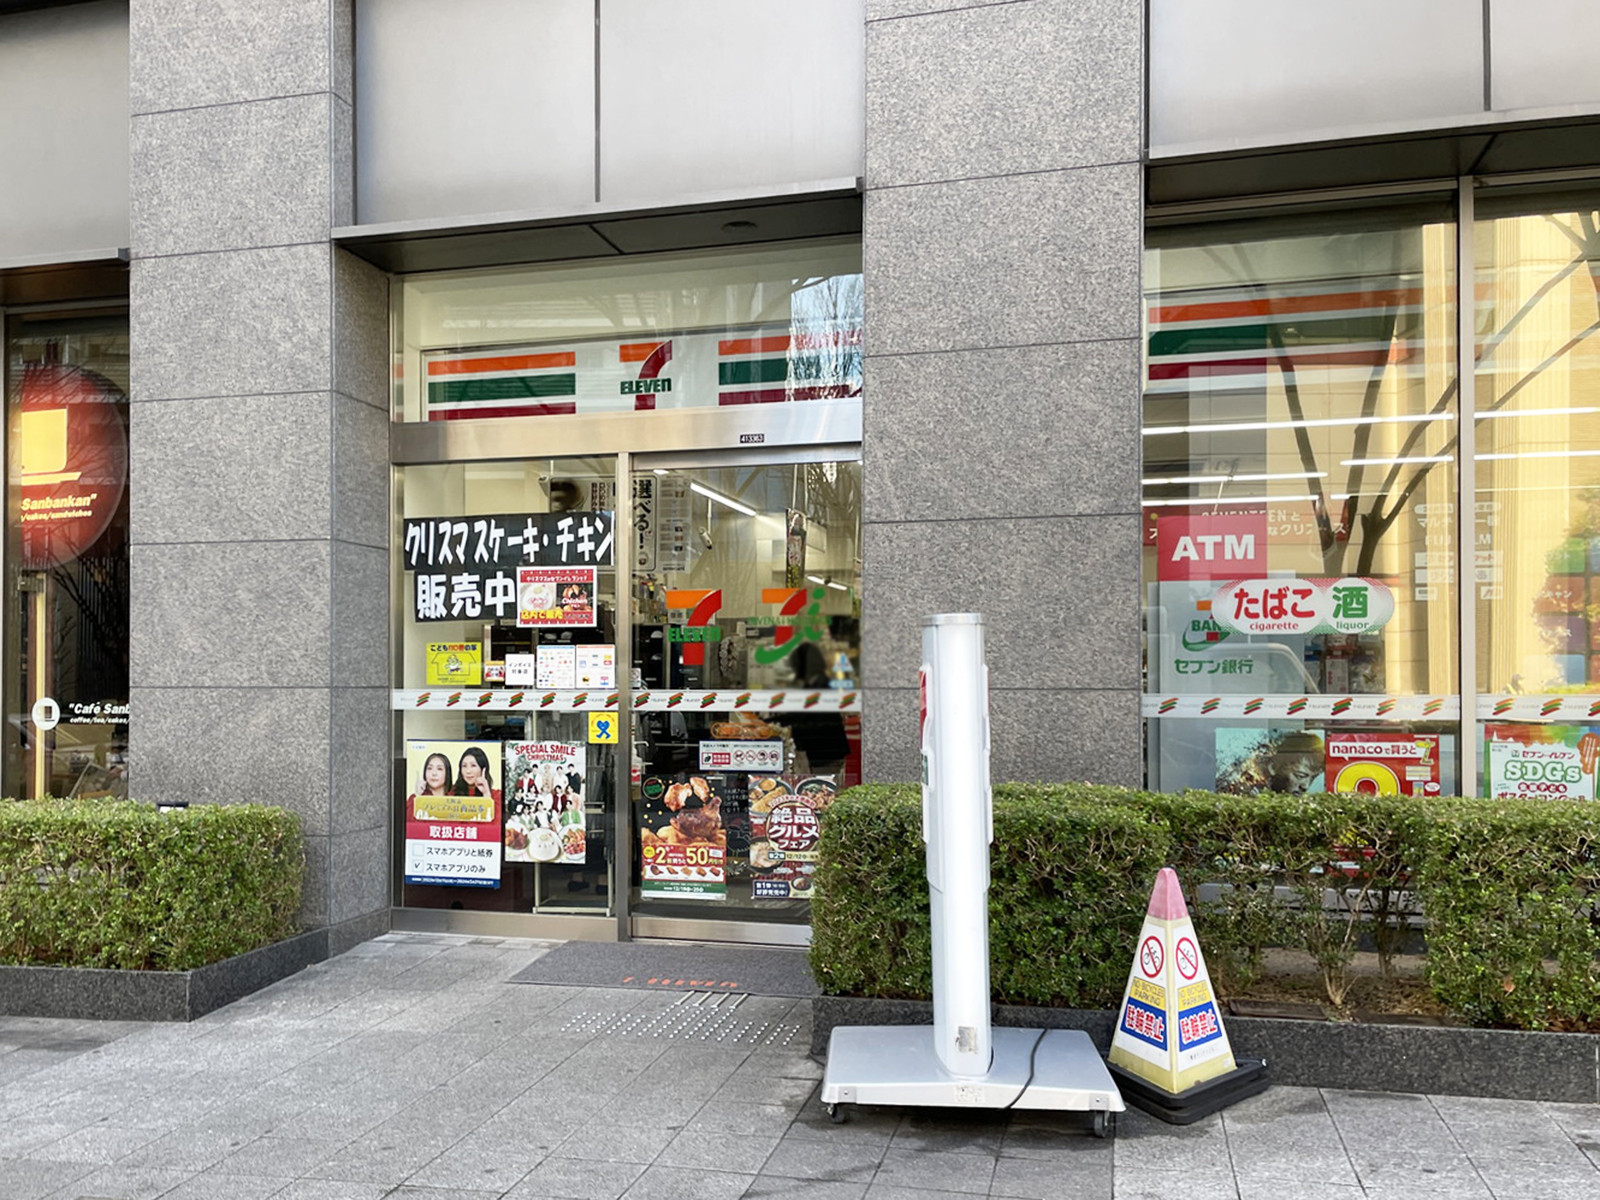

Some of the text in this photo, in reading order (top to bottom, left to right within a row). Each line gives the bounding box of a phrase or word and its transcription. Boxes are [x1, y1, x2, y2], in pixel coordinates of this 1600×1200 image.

[21, 493, 98, 511] Sanbankan"
[404, 516, 612, 566] クリスマスケーキ・チキン
[1171, 534, 1256, 562] ATM
[417, 571, 516, 619] 販売中
[1332, 586, 1369, 619] 酒
[1233, 586, 1316, 621] たばこ
[1191, 619, 1223, 631] BAN
[1249, 622, 1299, 631] cigarette
[1336, 620, 1370, 631] liquor
[1174, 658, 1254, 674] セブン銀行
[69, 701, 100, 715] "Café
[514, 744, 577, 757] SPECIAL SMILE
[526, 754, 564, 762] CHRISTMAS
[1504, 759, 1582, 784] SDGs
[771, 807, 816, 825] 絶品
[429, 825, 478, 840] 取扱店舗
[768, 824, 820, 839] グルメ
[777, 838, 811, 850] フェア
[426, 846, 493, 858] スマホアプリと紙券
[426, 862, 486, 874] スマホアプリのみ
